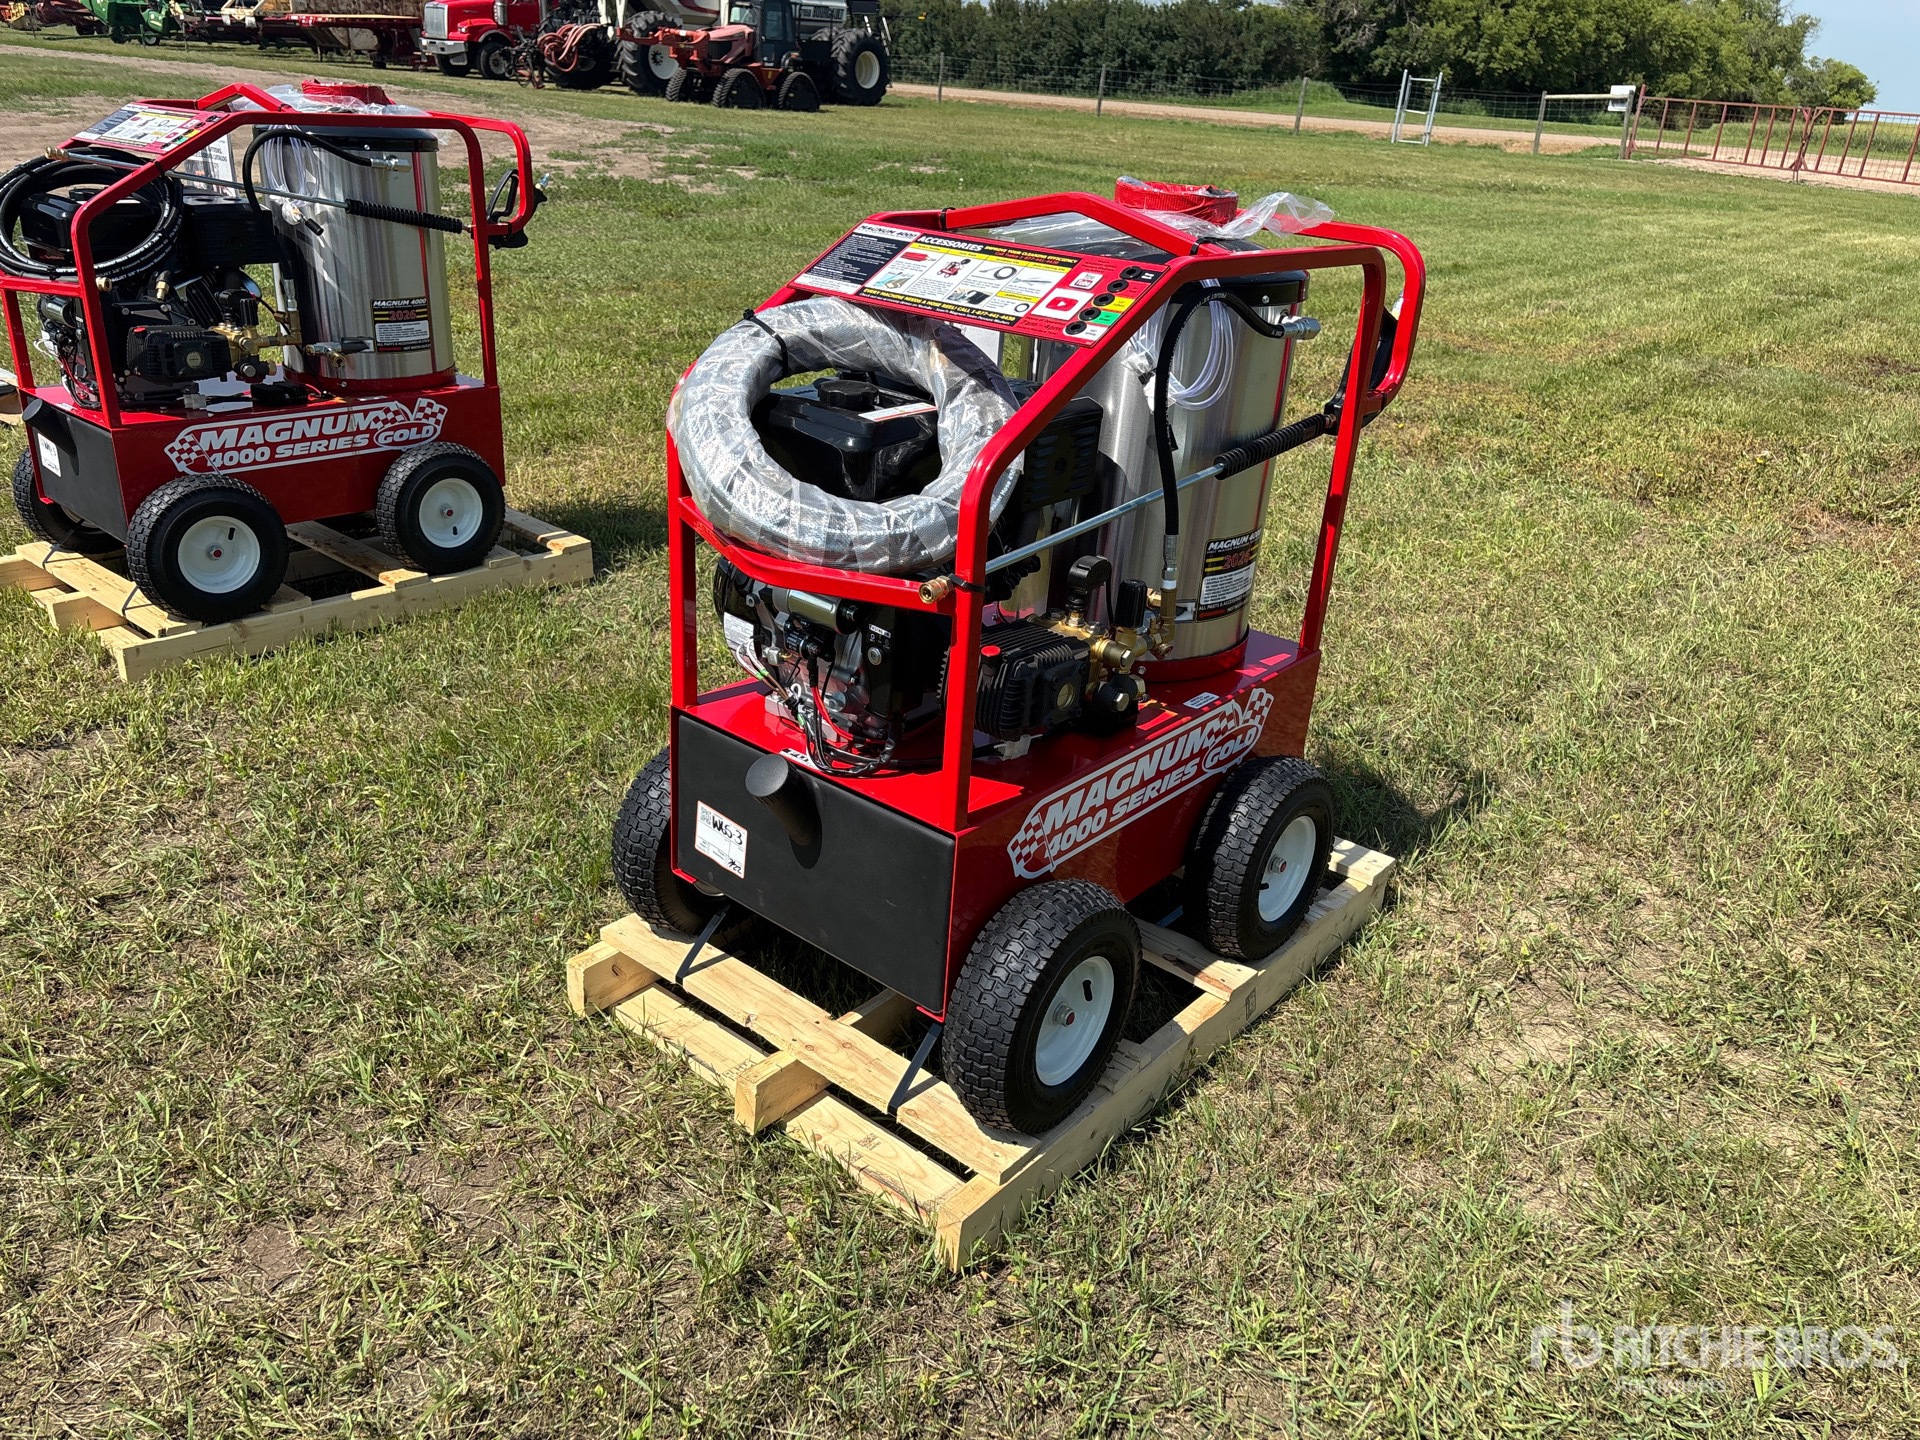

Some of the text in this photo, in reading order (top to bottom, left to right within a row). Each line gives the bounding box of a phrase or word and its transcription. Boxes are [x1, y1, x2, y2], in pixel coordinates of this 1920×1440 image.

[859, 225, 896, 236] MAGNUM
[917, 236, 984, 252] ACCESSORIES
[984, 245, 1008, 253] IMPROVE
[1021, 251, 1048, 259] CLEANING
[1047, 255, 1078, 264] EFFICIENCY
[880, 291, 905, 300] MACHINE
[904, 296, 923, 304] NEEDS
[389, 310, 417, 321] 2026
[1043, 323, 1062, 331] 4pm
[201, 410, 383, 450] MAGNUM
[377, 425, 434, 444] GOLD
[207, 434, 370, 468] 4000 SERIES
[1208, 535, 1250, 551] MAGNUM
[1205, 728, 1256, 769] GOLD
[1044, 719, 1221, 835] MAGNUM
[1045, 757, 1200, 858] 4000 SERIES
